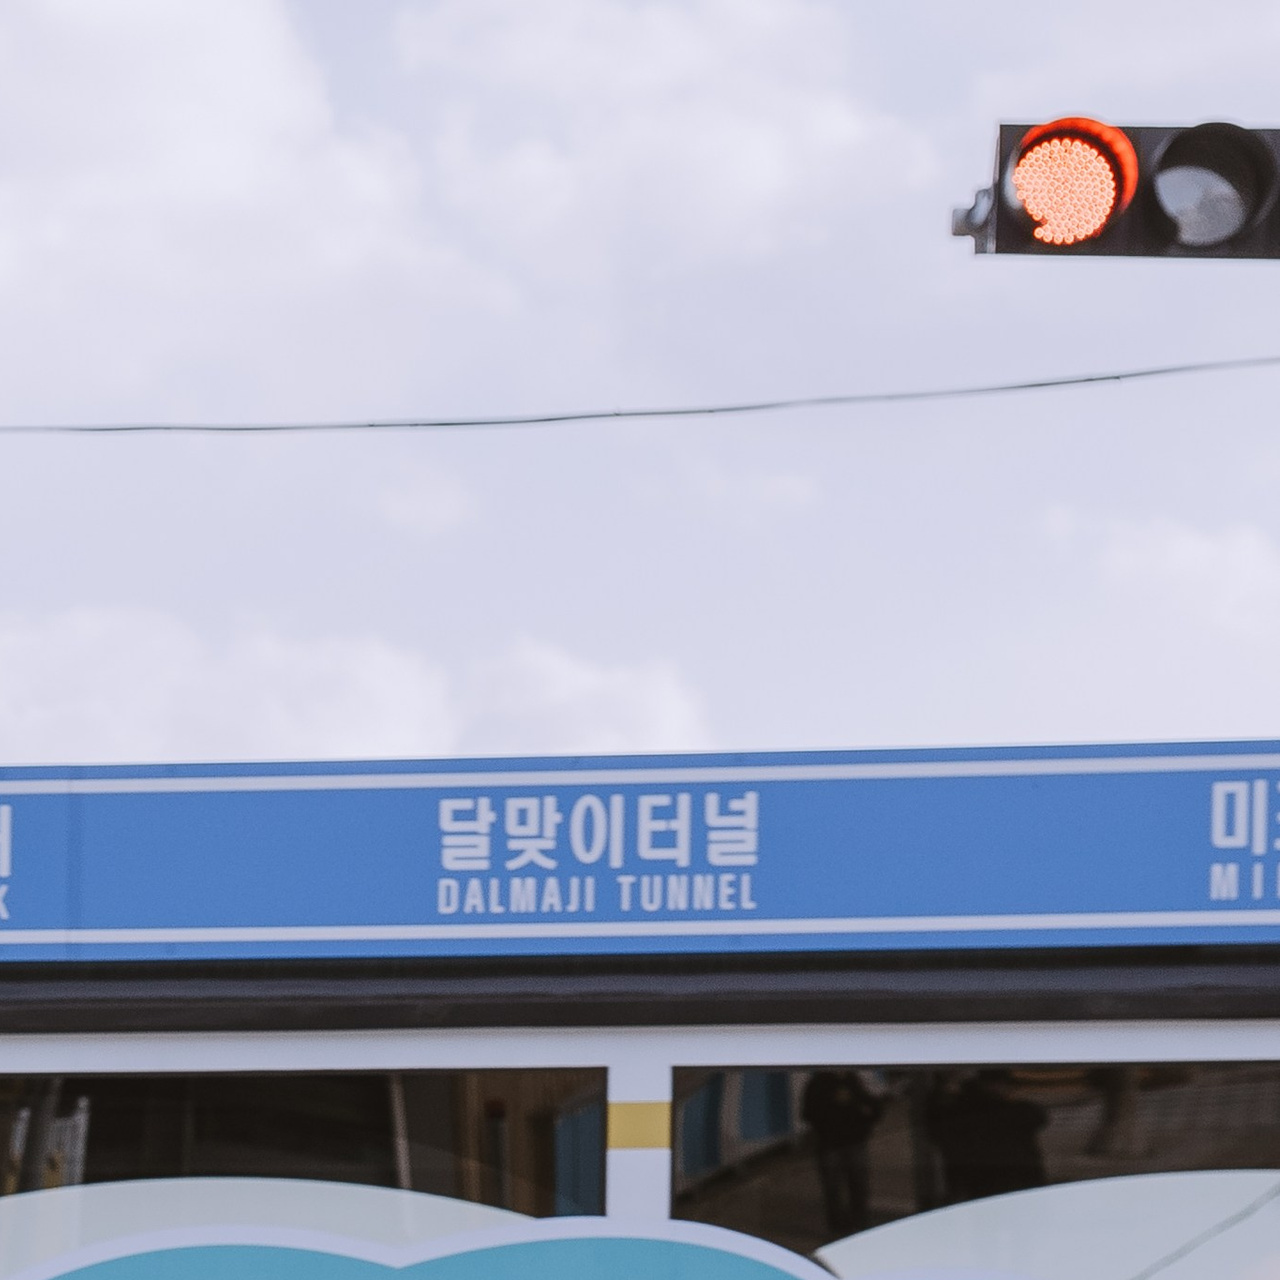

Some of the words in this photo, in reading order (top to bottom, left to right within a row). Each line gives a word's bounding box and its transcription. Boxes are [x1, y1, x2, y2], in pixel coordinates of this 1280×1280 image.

[438, 790, 759, 871] 달맞이터널
[1210, 779, 1280, 856] 미
[437, 876, 595, 915] DALMAJI
[616, 873, 757, 912] TUNNEL
[1210, 862, 1280, 901] MI
